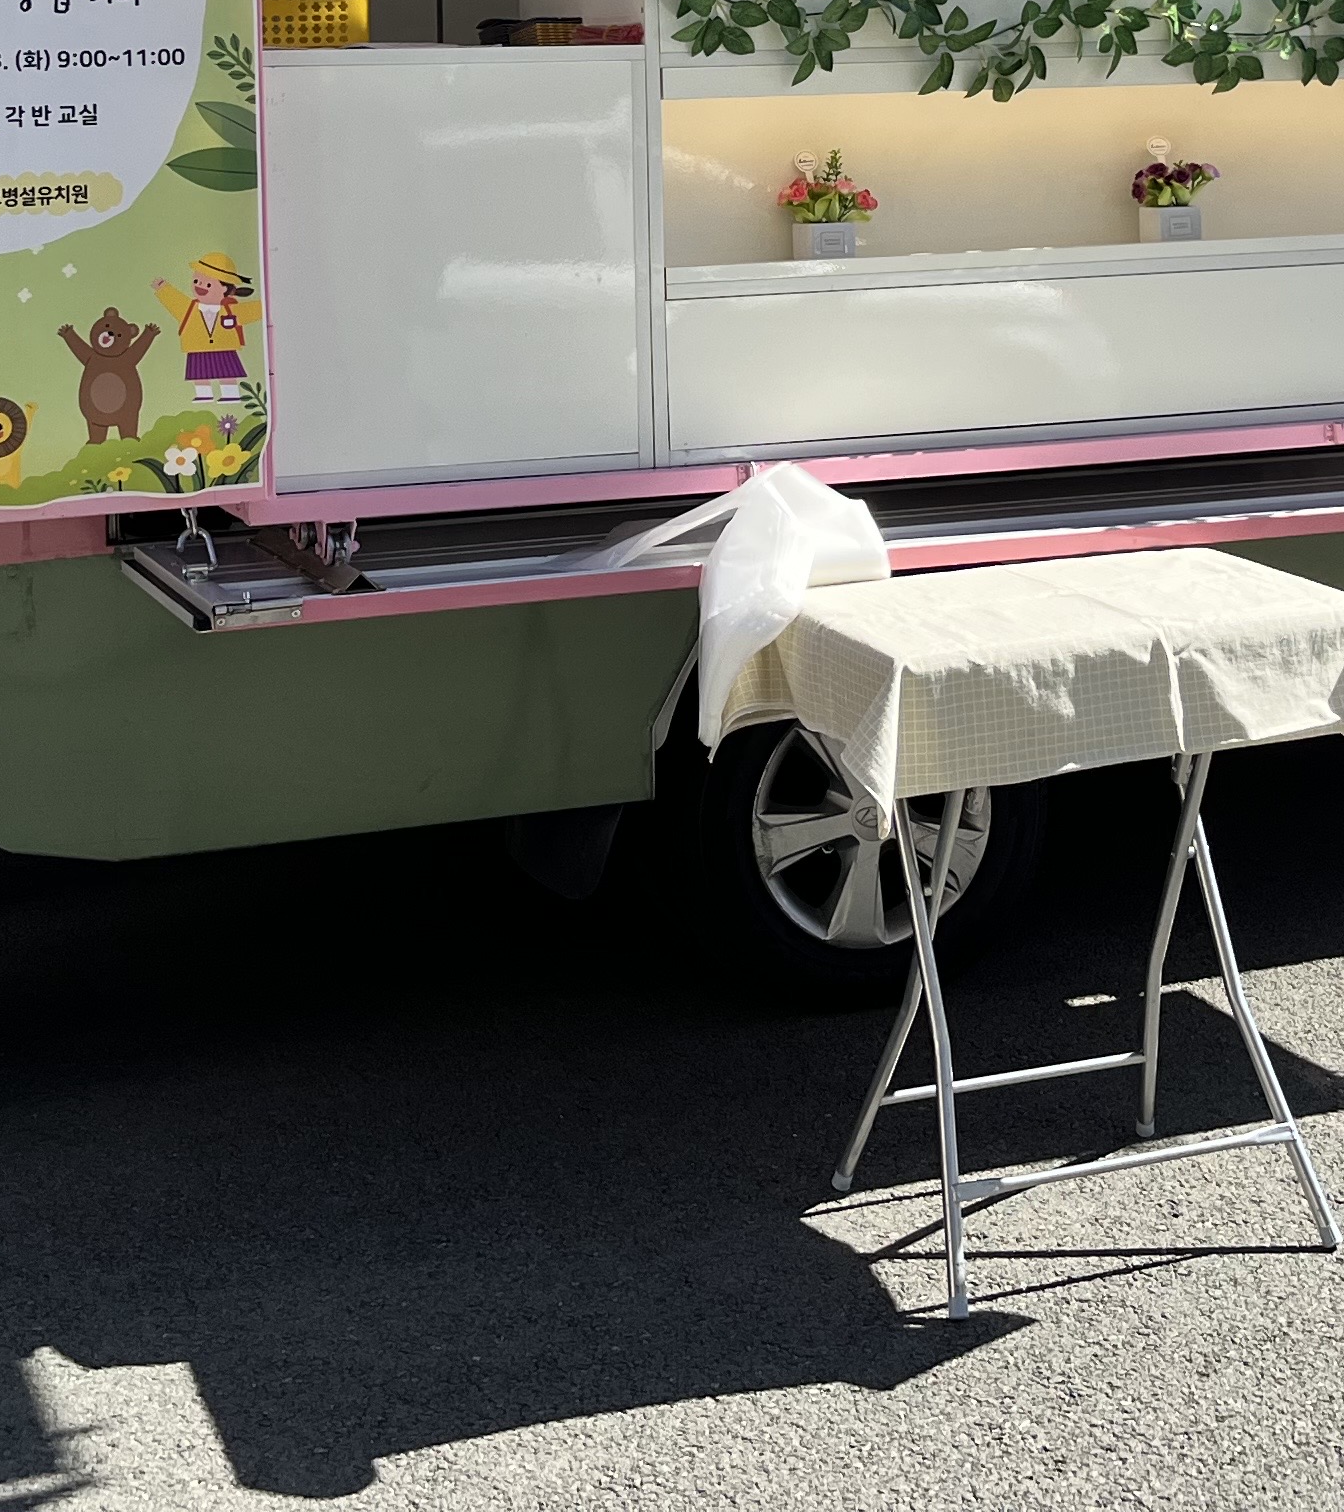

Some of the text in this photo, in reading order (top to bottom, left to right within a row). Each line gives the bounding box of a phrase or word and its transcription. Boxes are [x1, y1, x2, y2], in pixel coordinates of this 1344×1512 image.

[15, 49, 51, 72] (화)
[57, 48, 186, 69] 9:00~11:00
[5, 106, 26, 128] 각
[31, 105, 52, 127] 반
[57, 103, 99, 126] 교실
